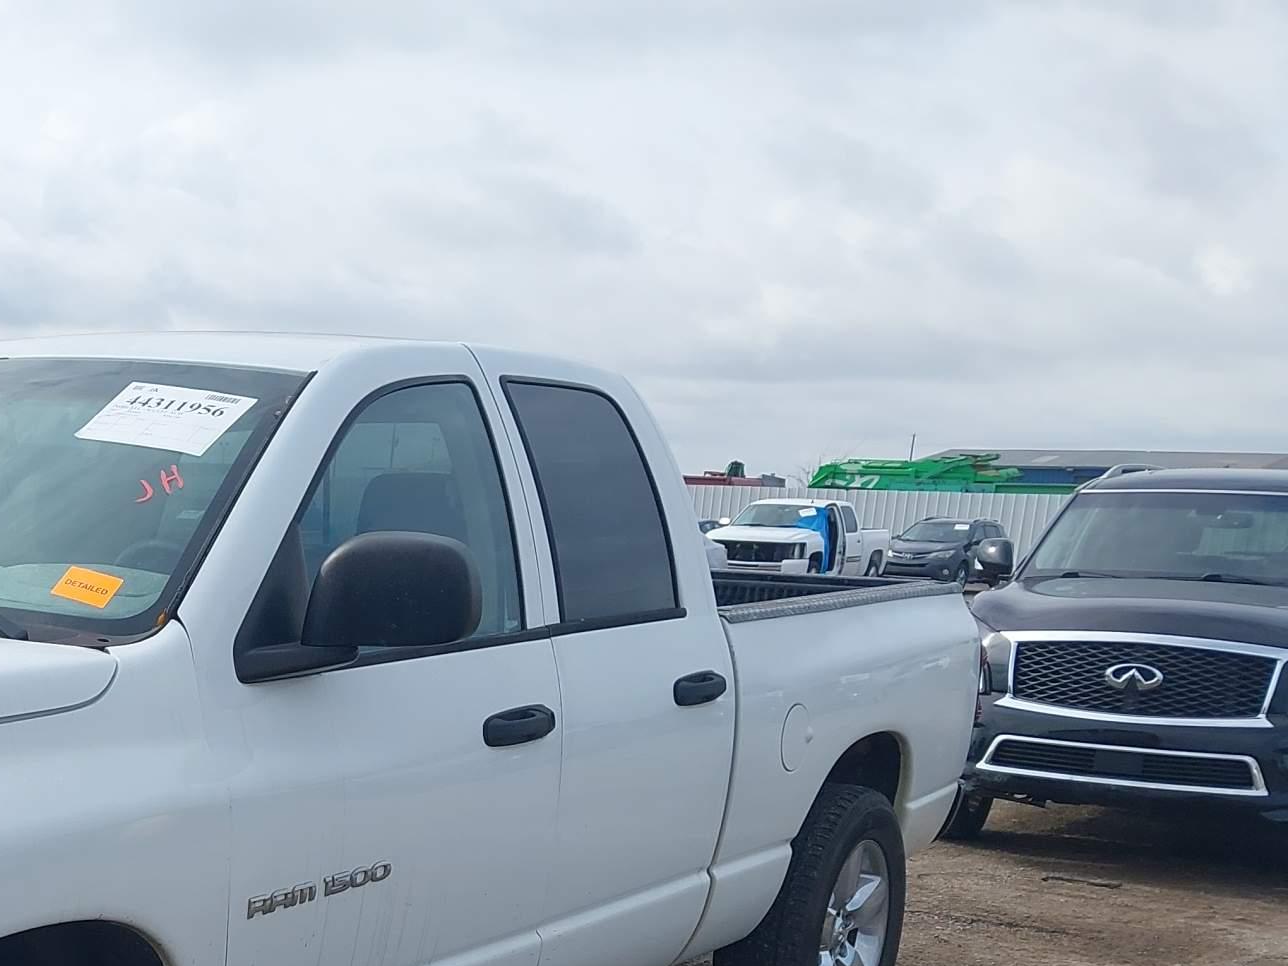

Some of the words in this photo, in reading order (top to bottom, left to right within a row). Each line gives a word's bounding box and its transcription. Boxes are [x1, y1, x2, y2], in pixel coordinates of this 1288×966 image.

[125, 395, 229, 418] 44311956
[64, 578, 108, 596] DETAILED
[247, 881, 317, 920] RAM
[323, 860, 392, 897] 1500
